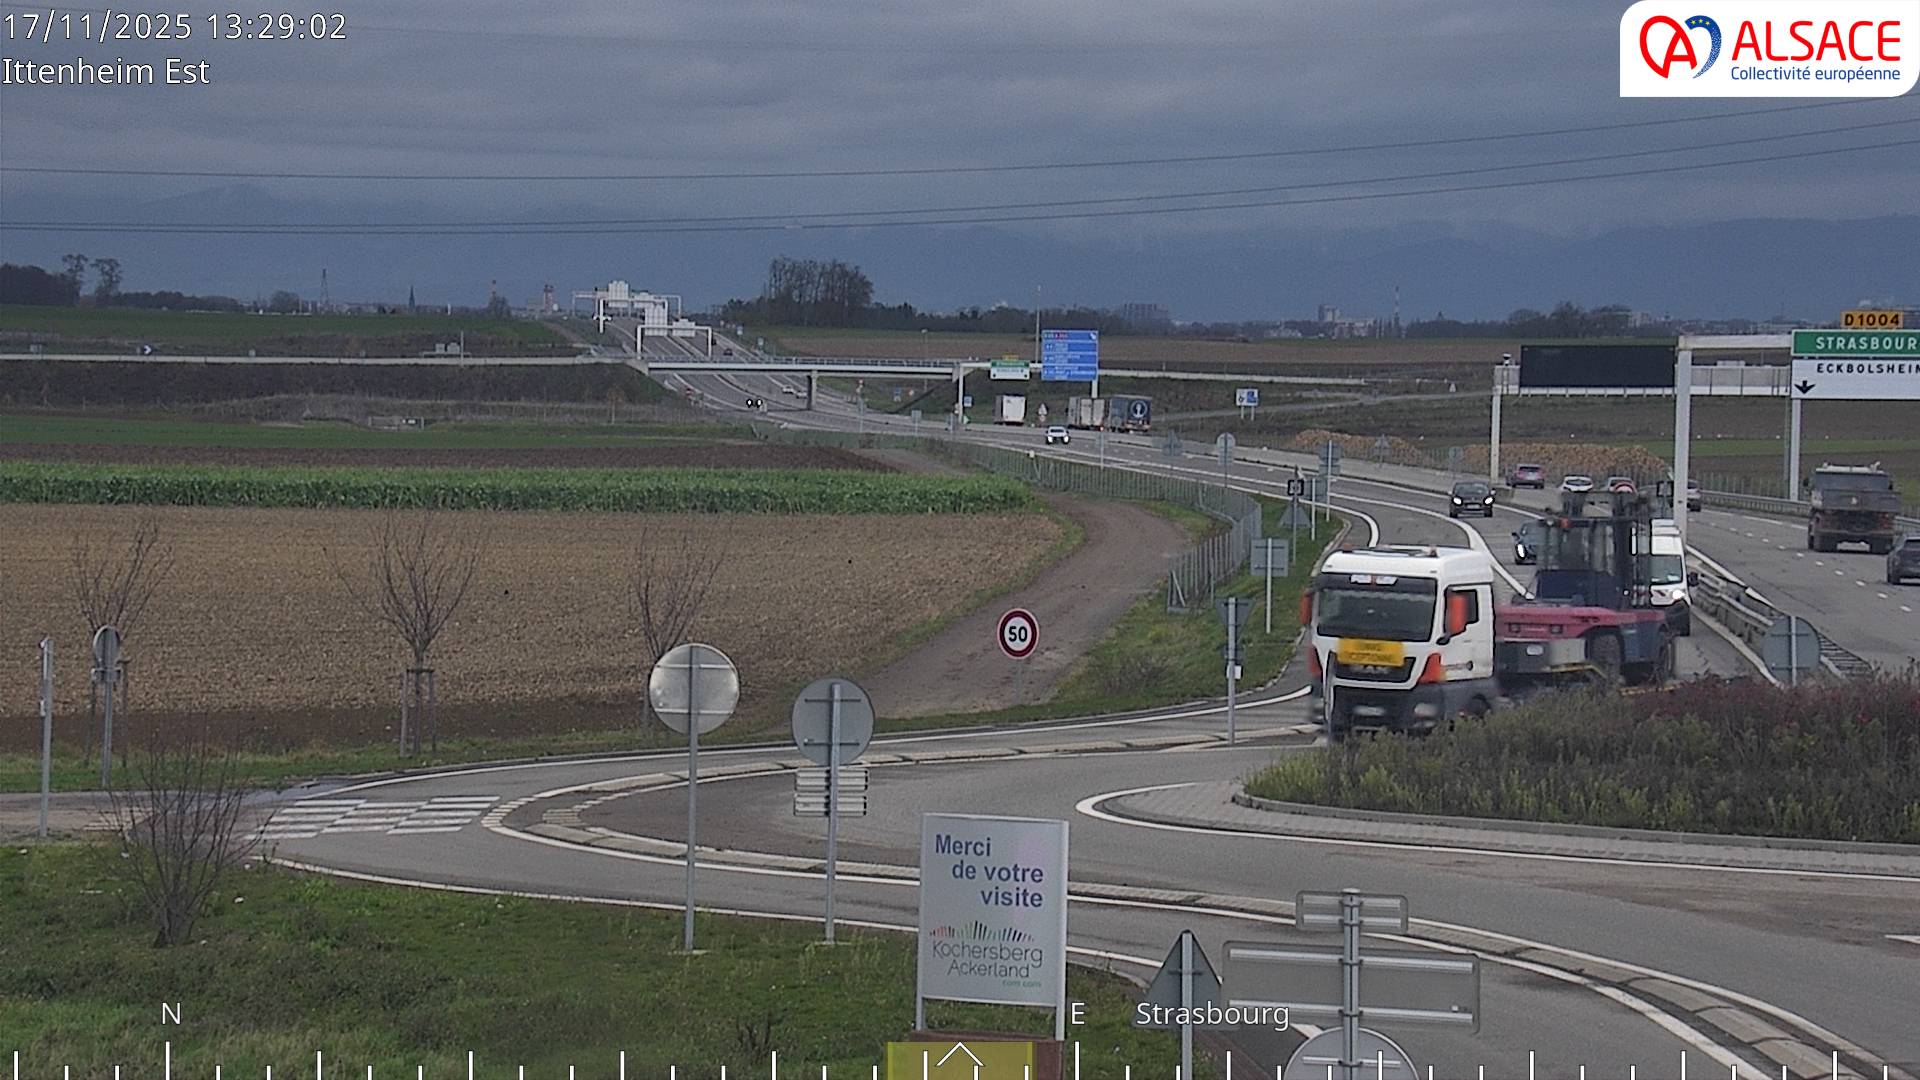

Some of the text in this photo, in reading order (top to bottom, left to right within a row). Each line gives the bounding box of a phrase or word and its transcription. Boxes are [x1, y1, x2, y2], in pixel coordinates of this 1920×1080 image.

[1815, 336, 1920, 350] STRASBOUR
[1008, 625, 1028, 642] 50
[935, 833, 991, 857] Merci
[952, 860, 1044, 883] de votre
[981, 886, 1043, 908] visite
[932, 940, 1043, 968] Kochersberg
[947, 959, 1030, 978] Ackerland
